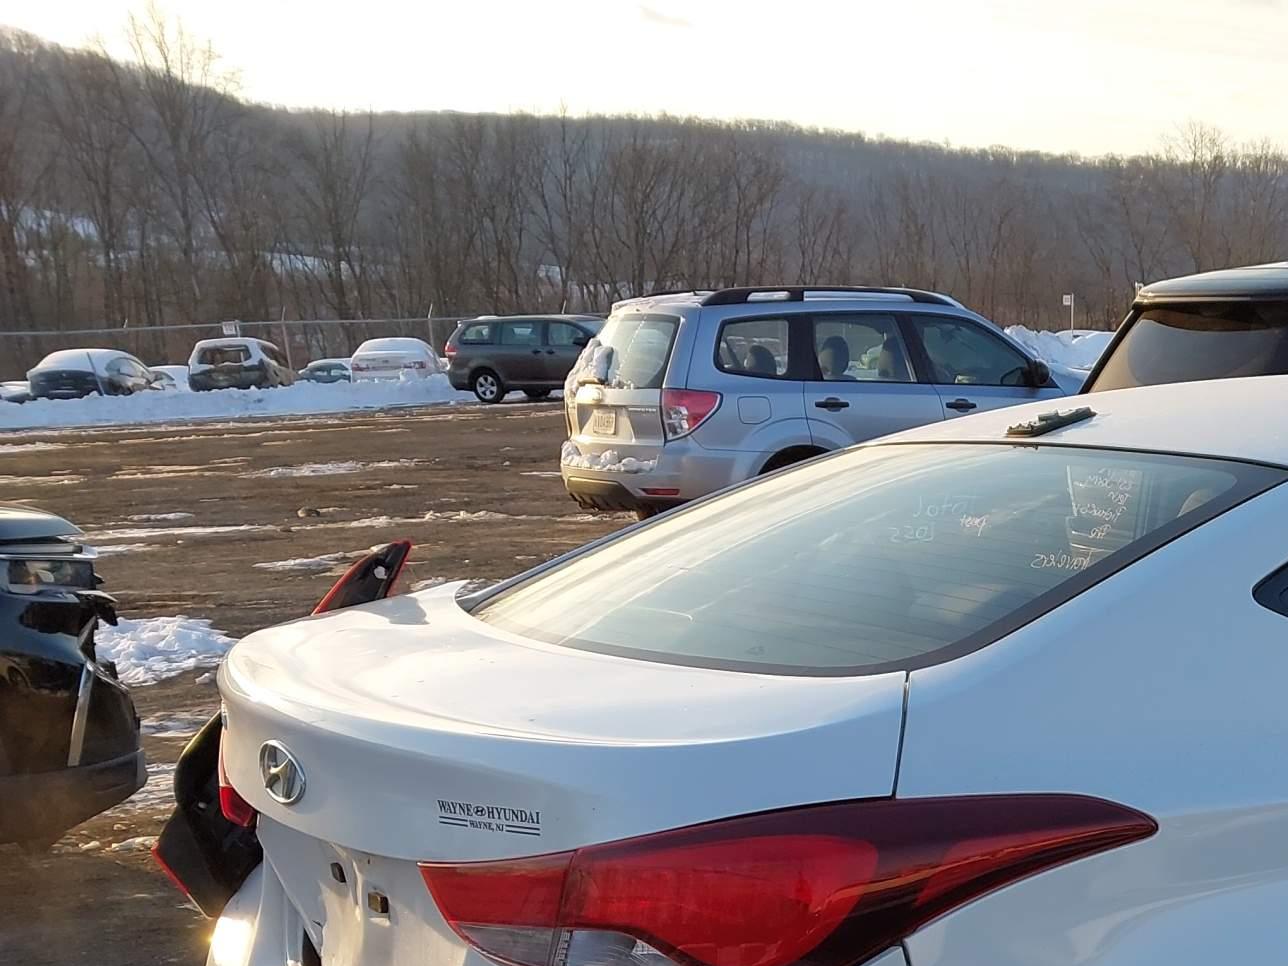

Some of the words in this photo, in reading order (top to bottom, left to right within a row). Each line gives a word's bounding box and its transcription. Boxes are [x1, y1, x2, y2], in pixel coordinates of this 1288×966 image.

[437, 800, 472, 816] WAYNE
[487, 806, 540, 824] HYUNDAI
[469, 820, 495, 832] WAYNE,
[495, 824, 505, 832] NJ
